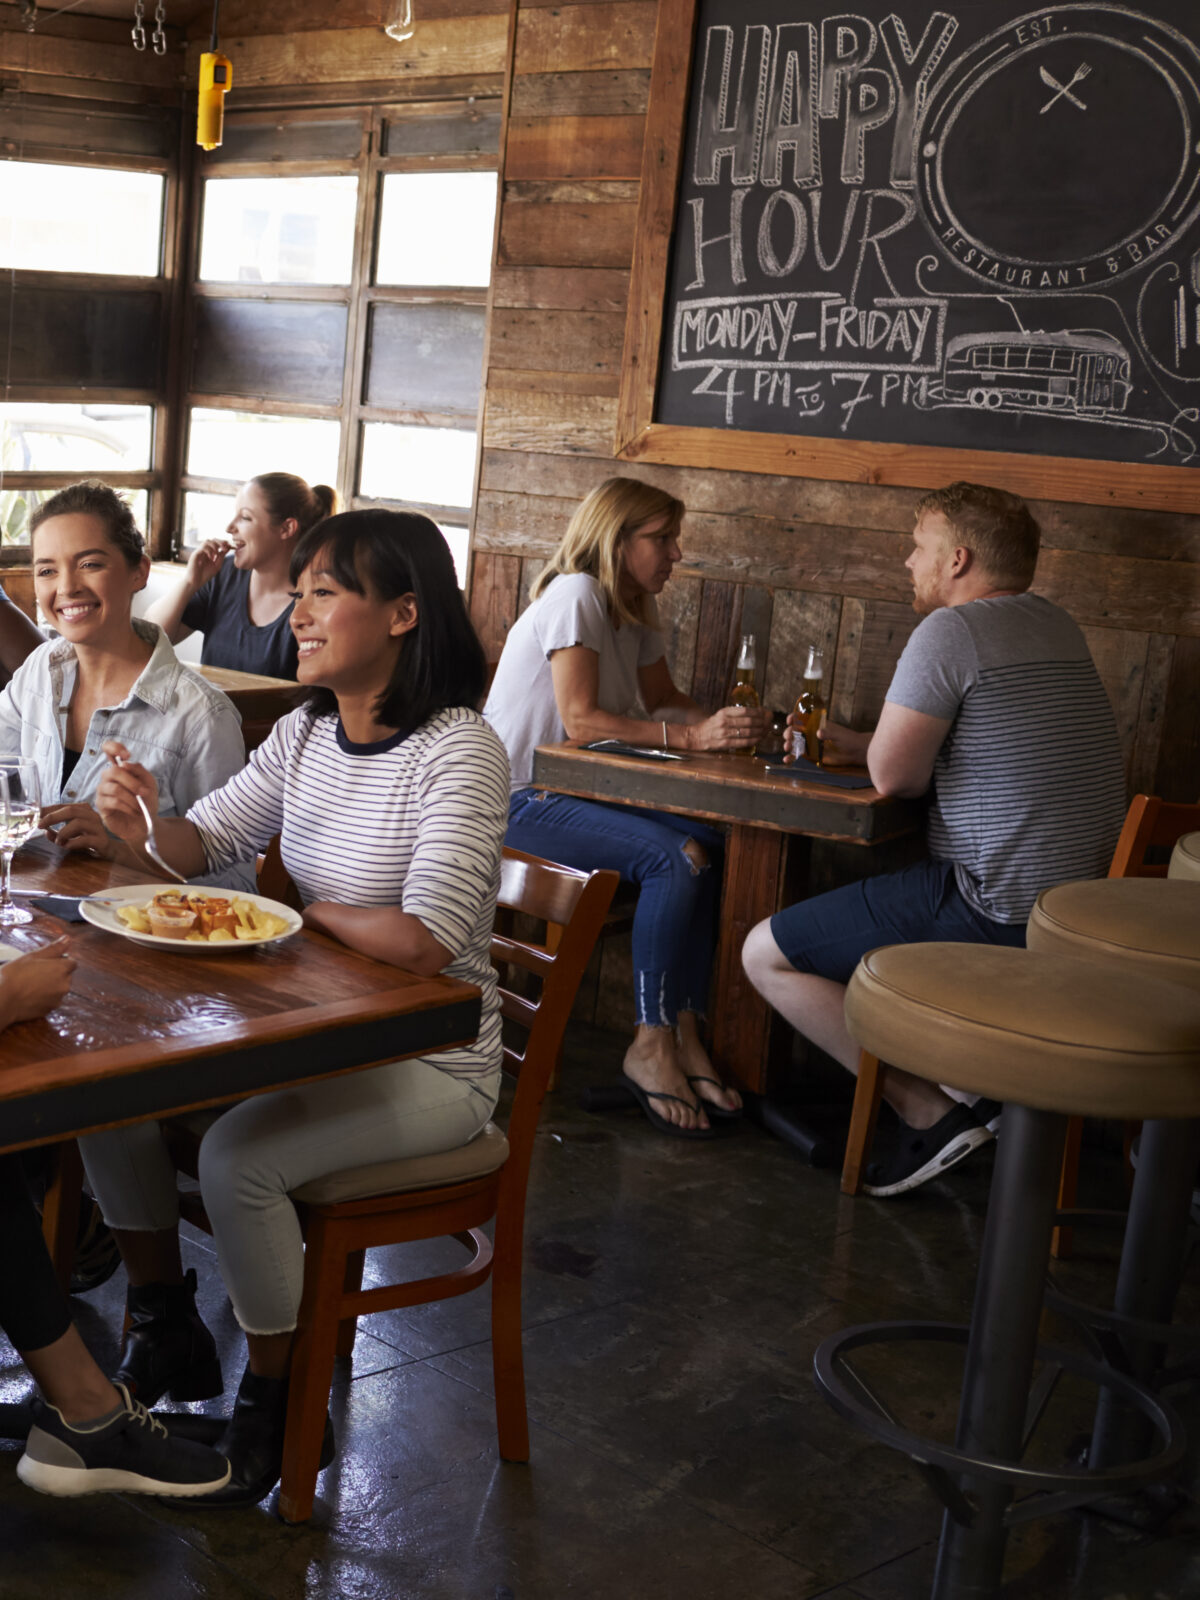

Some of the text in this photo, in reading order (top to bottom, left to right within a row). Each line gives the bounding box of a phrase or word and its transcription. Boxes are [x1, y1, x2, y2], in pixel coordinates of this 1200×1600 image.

[1015, 15, 1068, 44] EST.
[694, 11, 959, 189] HAPPY
[685, 188, 917, 306] HOUR
[942, 223, 1172, 287] RESTAURANT & BAR
